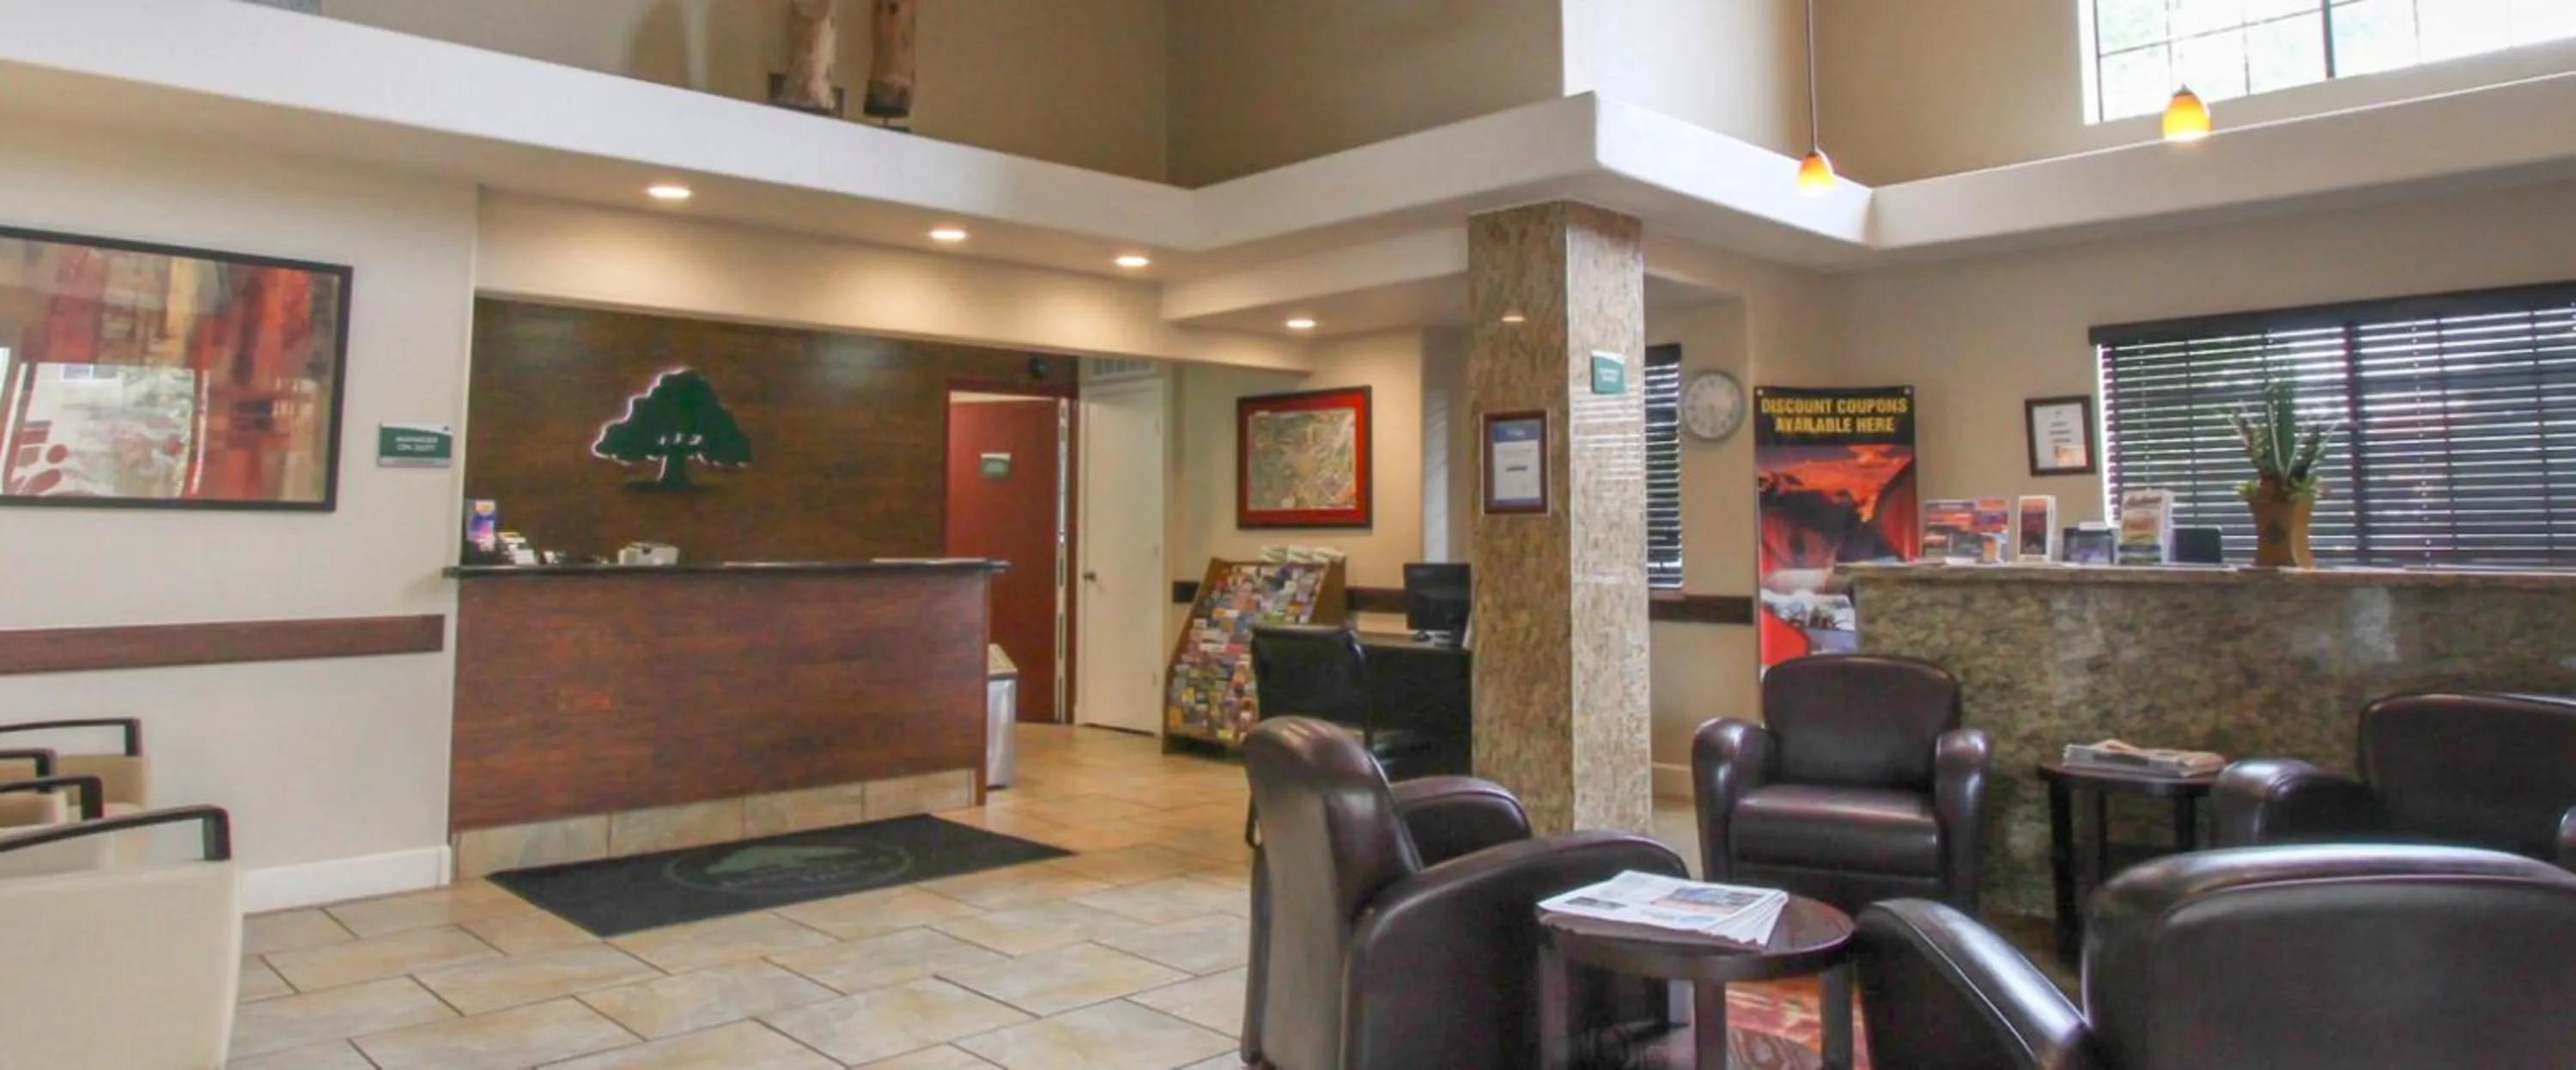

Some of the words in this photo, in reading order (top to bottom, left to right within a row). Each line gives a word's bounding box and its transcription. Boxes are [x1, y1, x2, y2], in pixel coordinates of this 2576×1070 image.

[1760, 398, 1833, 413] DISCOUNT
[1837, 397, 1908, 413] COUPONS
[1774, 416, 1852, 433] AVAILABLE
[1856, 416, 1895, 432] HERE
